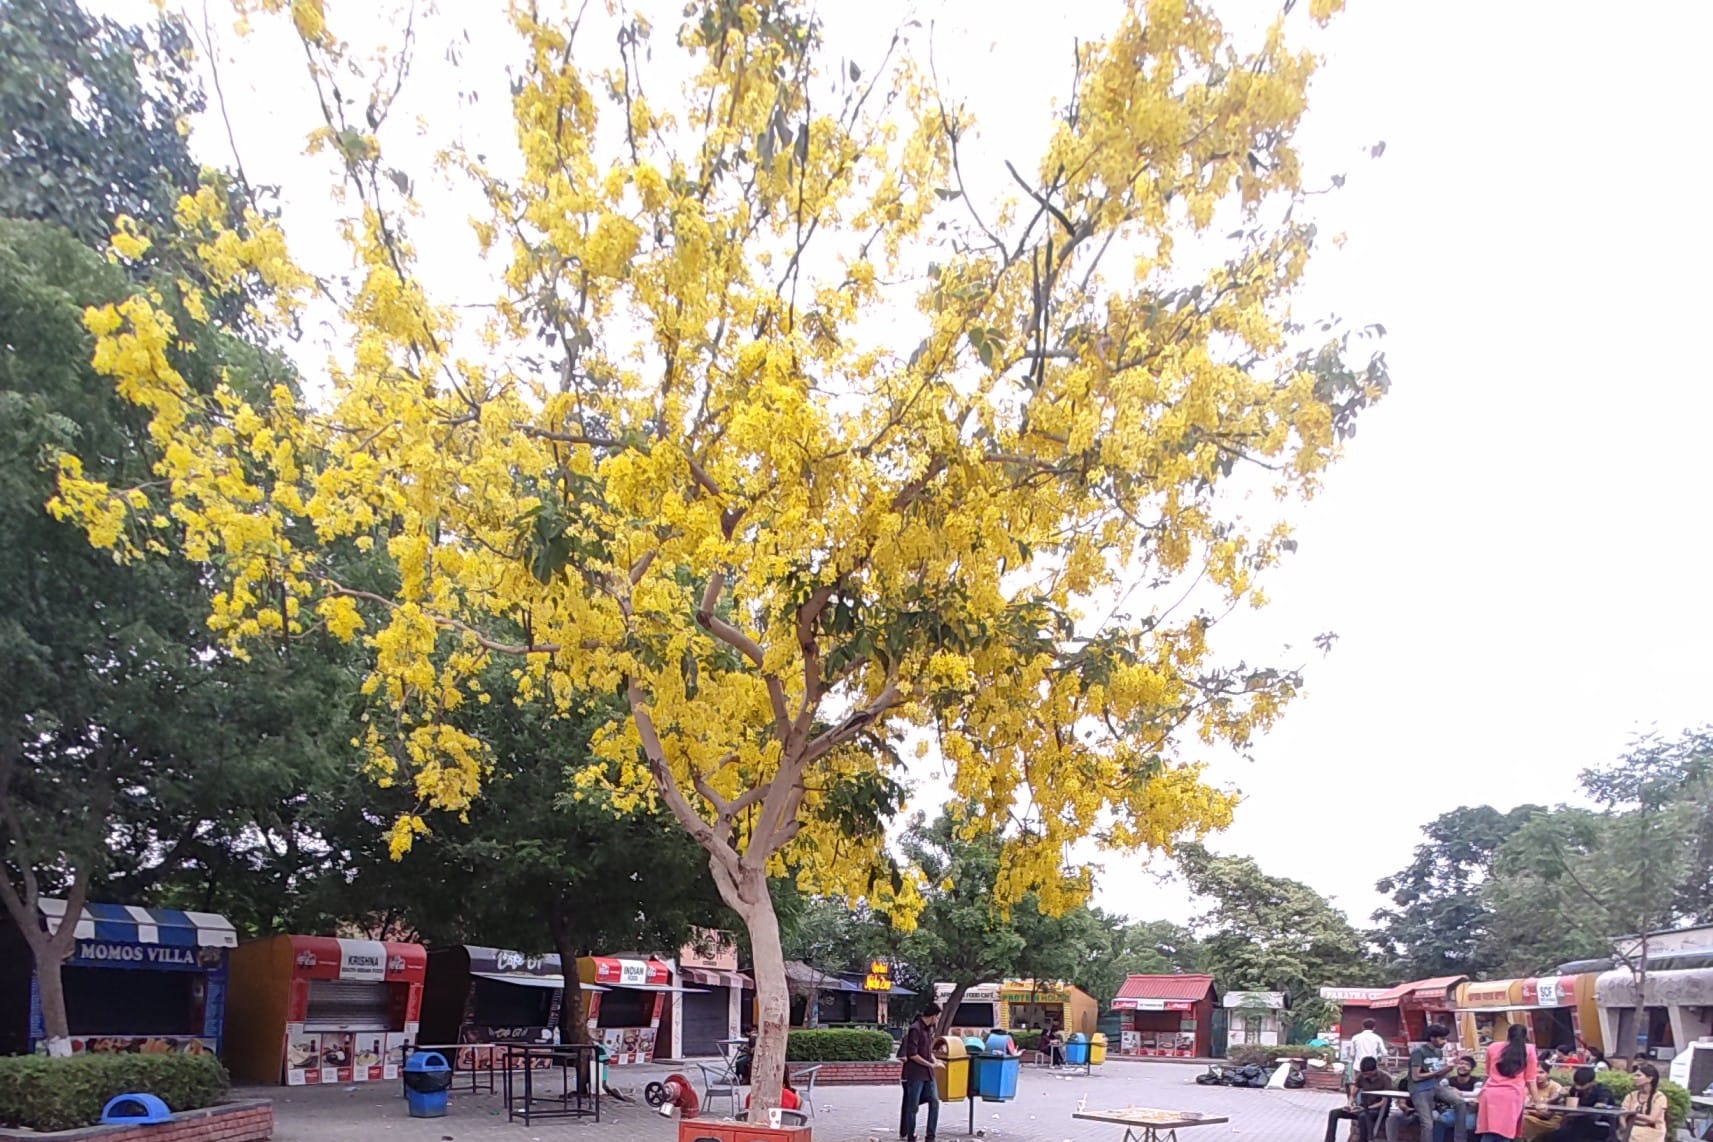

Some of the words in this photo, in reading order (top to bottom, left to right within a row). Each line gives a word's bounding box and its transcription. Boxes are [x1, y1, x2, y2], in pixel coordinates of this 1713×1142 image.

[80, 943, 144, 961] MOMOS
[147, 947, 195, 964] VILLA
[347, 955, 380, 967] KRISHNA
[623, 966, 645, 976] INDIAN
[1001, 992, 1039, 1003] PROTEN
